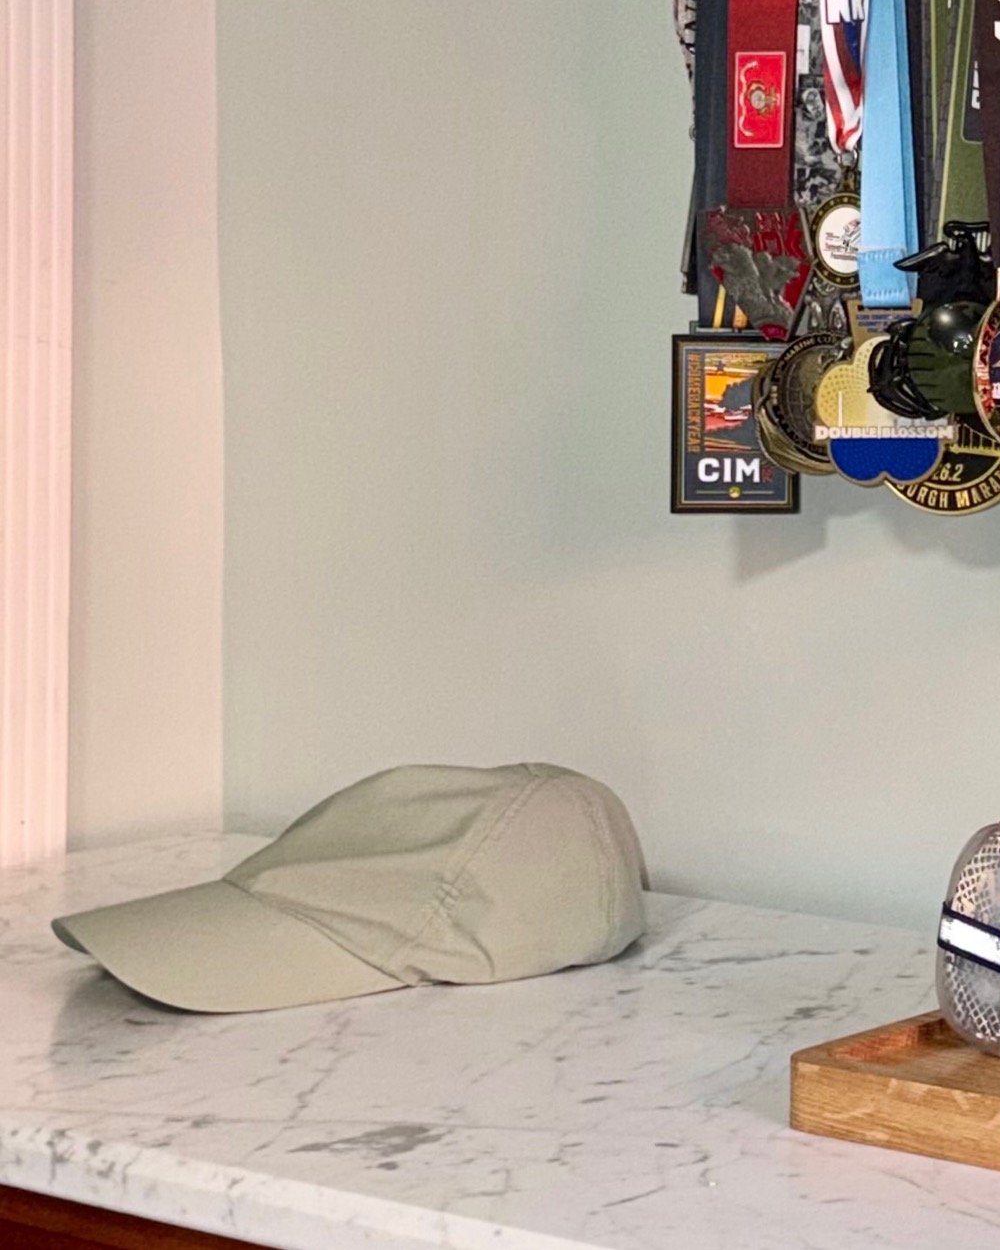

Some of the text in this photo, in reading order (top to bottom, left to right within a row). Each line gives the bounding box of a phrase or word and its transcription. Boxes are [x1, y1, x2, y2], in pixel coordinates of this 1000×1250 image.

[815, 424, 954, 441] DOUBLE BLOSSOM
[697, 457, 761, 484] CIM
